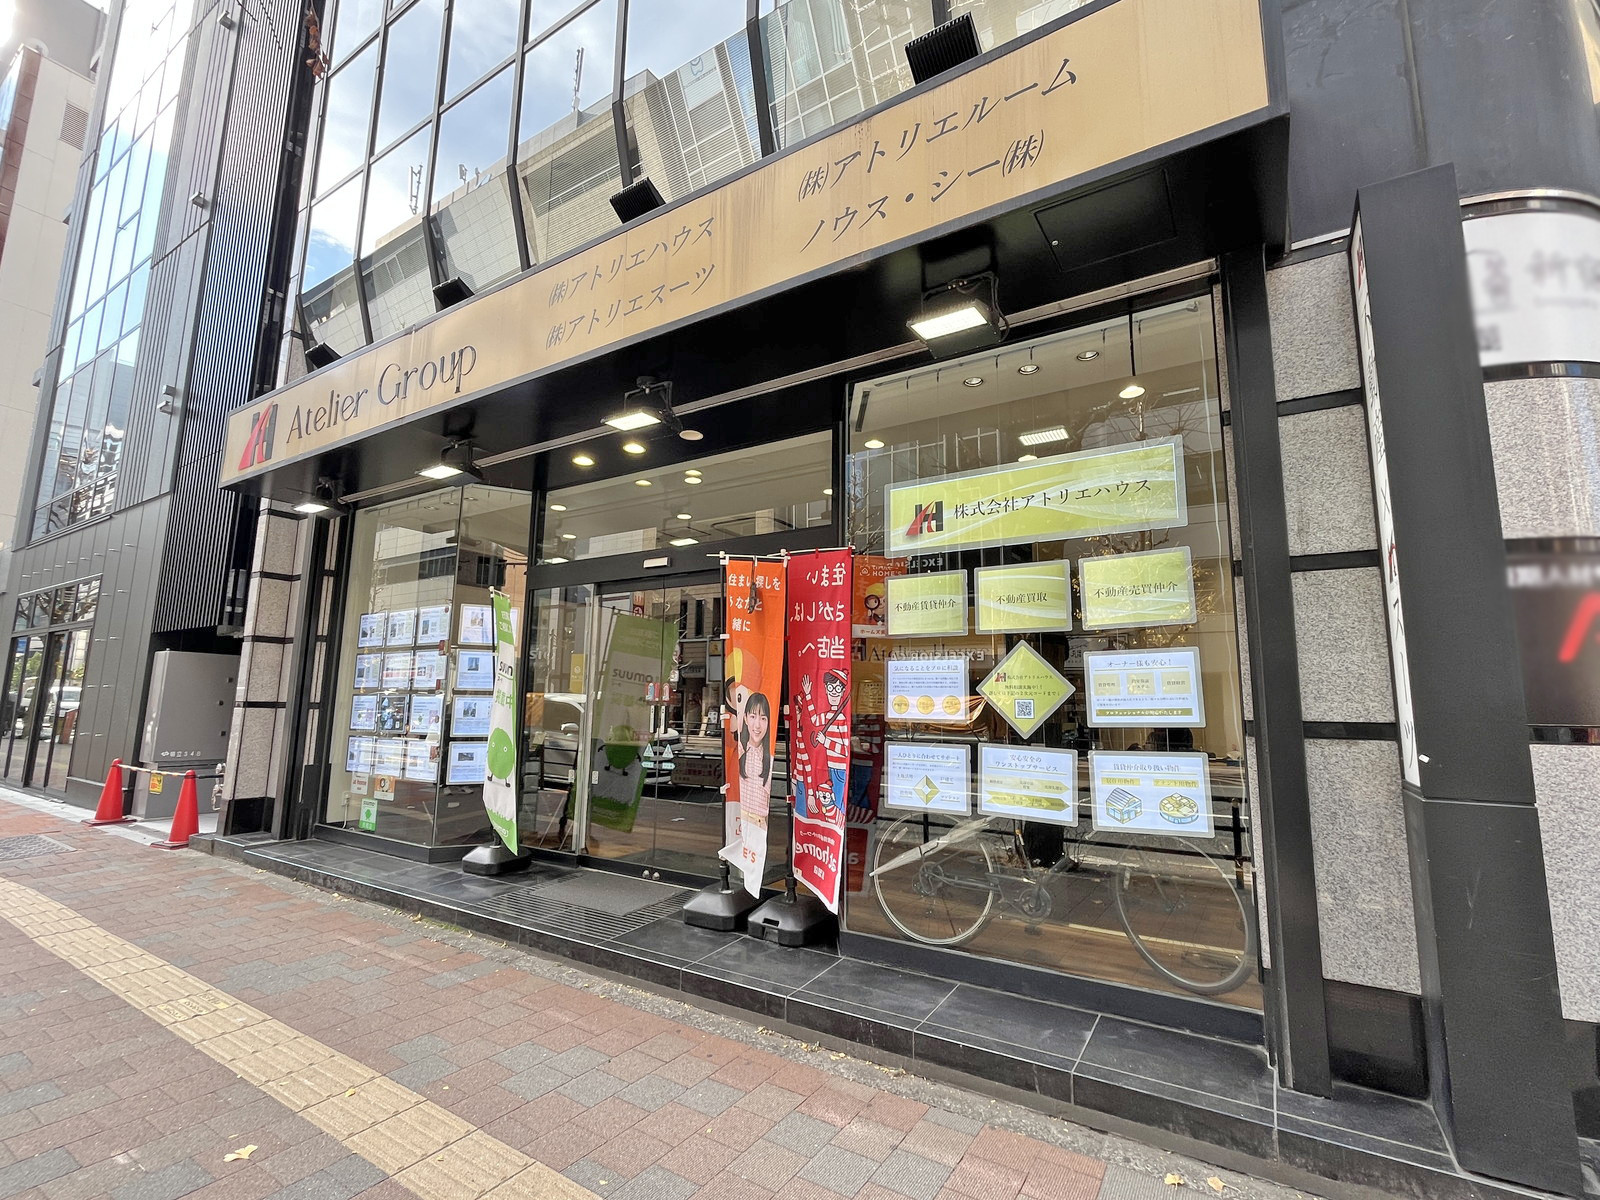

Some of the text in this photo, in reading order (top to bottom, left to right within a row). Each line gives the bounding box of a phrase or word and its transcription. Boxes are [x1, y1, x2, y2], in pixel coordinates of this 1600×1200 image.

[798, 58, 1077, 202] (株)アトリエルーム
[547, 216, 716, 308] (株)アトリエハウス
[545, 263, 716, 351] (株)アトリエスーツ
[286, 344, 477, 444] Atelier Group
[954, 478, 1151, 520] 株式会社アトリエハウス
[894, 598, 957, 612] 不動産賃貸仲介
[996, 591, 1048, 606] 不動産買取
[1094, 581, 1178, 599] 不動産売買仲介
[995, 760, 1058, 772] ワンストップサービス
